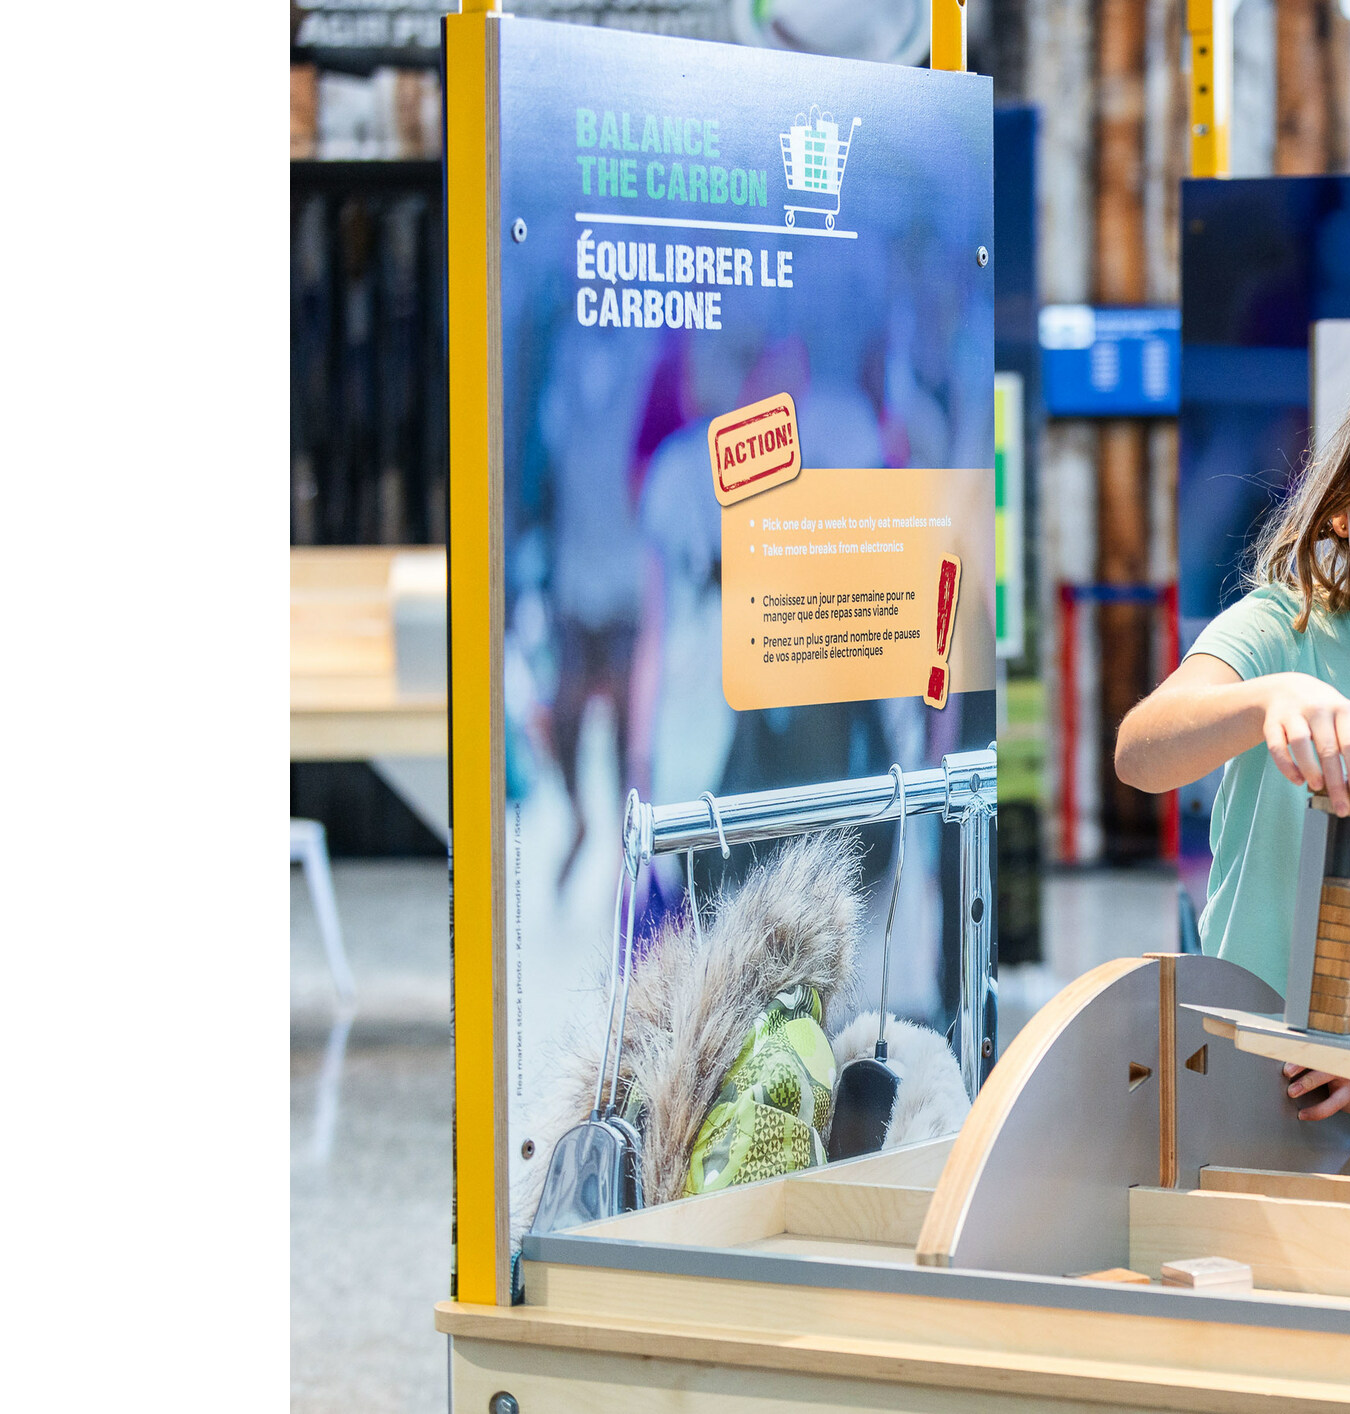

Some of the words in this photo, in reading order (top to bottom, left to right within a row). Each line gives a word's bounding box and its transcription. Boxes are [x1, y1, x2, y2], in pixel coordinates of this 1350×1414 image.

[576, 108, 721, 158] BALANCE
[576, 155, 638, 198] THE
[646, 161, 768, 208] CARBON
[576, 229, 753, 286] ÉQUILIBRER
[760, 249, 794, 288] LE
[576, 286, 722, 330] CARBONE
[724, 422, 793, 470] ACTION!
[762, 517, 782, 531] Pick
[783, 520, 799, 530] one
[800, 517, 816, 532] day
[818, 520, 823, 529] a
[824, 516, 847, 529] week
[848, 517, 857, 528] to
[859, 516, 876, 531] only
[877, 517, 891, 528] eat
[892, 515, 927, 528] meatless
[928, 514, 952, 527] meals
[762, 544, 783, 556] Take
[785, 545, 807, 556] more
[809, 541, 837, 555] breaks
[839, 541, 858, 554] from
[860, 540, 904, 553] electronics
[763, 594, 805, 607] Choisissez
[807, 596, 817, 605] un
[819, 592, 835, 607] jour
[837, 594, 850, 606] par
[852, 590, 884, 602] semaine
[886, 591, 904, 604] pour
[905, 591, 915, 600] ne
[763, 611, 796, 624] manger
[797, 610, 813, 623] que
[815, 608, 829, 619] des
[831, 608, 852, 621] repas
[854, 607, 871, 617] sans
[873, 604, 898, 616] viande
[763, 636, 792, 648] Prenez
[794, 636, 804, 645] un
[806, 633, 823, 648] plus
[825, 631, 848, 647] grand
[850, 629, 881, 642] nombre
[883, 629, 892, 640] de
[894, 629, 920, 642] pauses
[763, 651, 774, 663] de
[776, 652, 789, 662] vos
[791, 647, 828, 663] appareils
[829, 644, 883, 659] électroniques
[515, 960, 523, 993] photo
[515, 997, 523, 1026] stock
